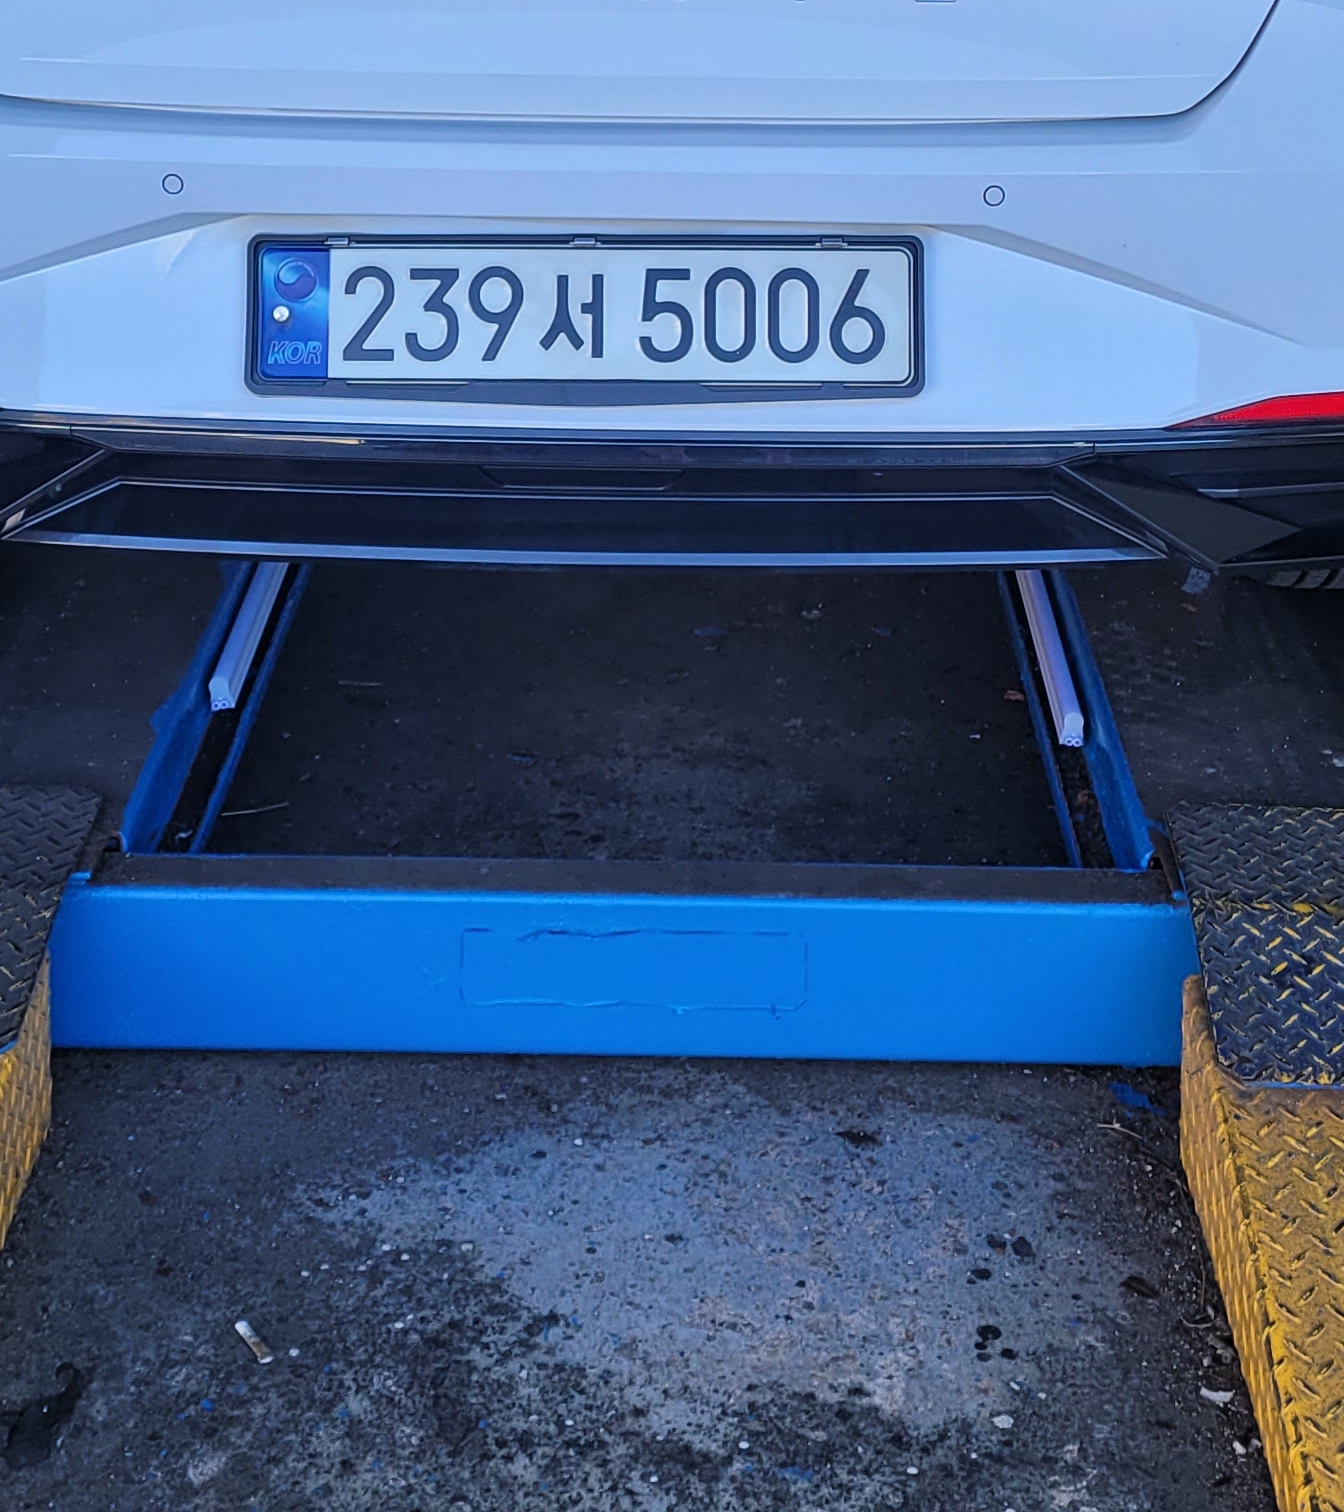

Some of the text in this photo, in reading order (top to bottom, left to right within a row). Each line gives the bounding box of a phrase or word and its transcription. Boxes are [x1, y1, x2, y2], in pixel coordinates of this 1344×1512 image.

[341, 265, 886, 365] 239서 5006
[267, 340, 323, 365] KOR
